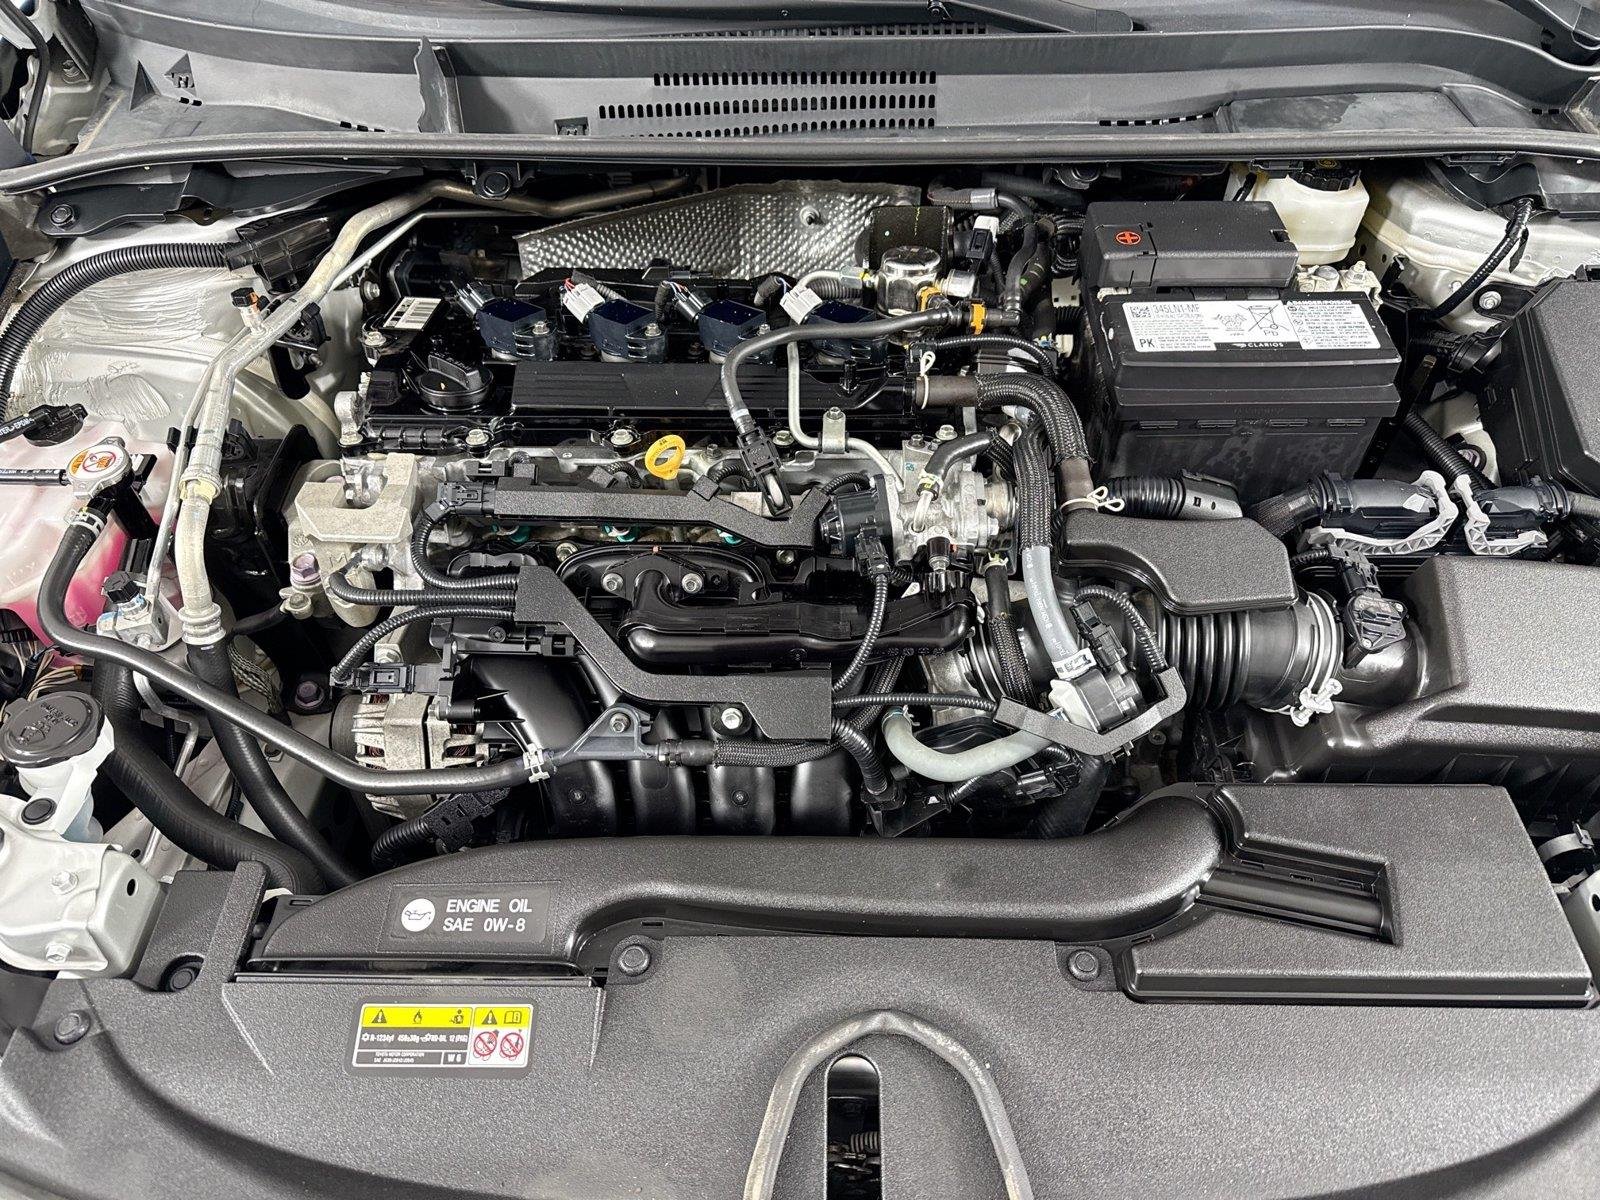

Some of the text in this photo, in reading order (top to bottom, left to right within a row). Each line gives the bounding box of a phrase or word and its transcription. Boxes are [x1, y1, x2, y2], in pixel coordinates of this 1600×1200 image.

[1139, 338, 1155, 348] PK
[446, 898, 533, 913] ENGINE OIL
[442, 917, 526, 932] SAE 0W-8
